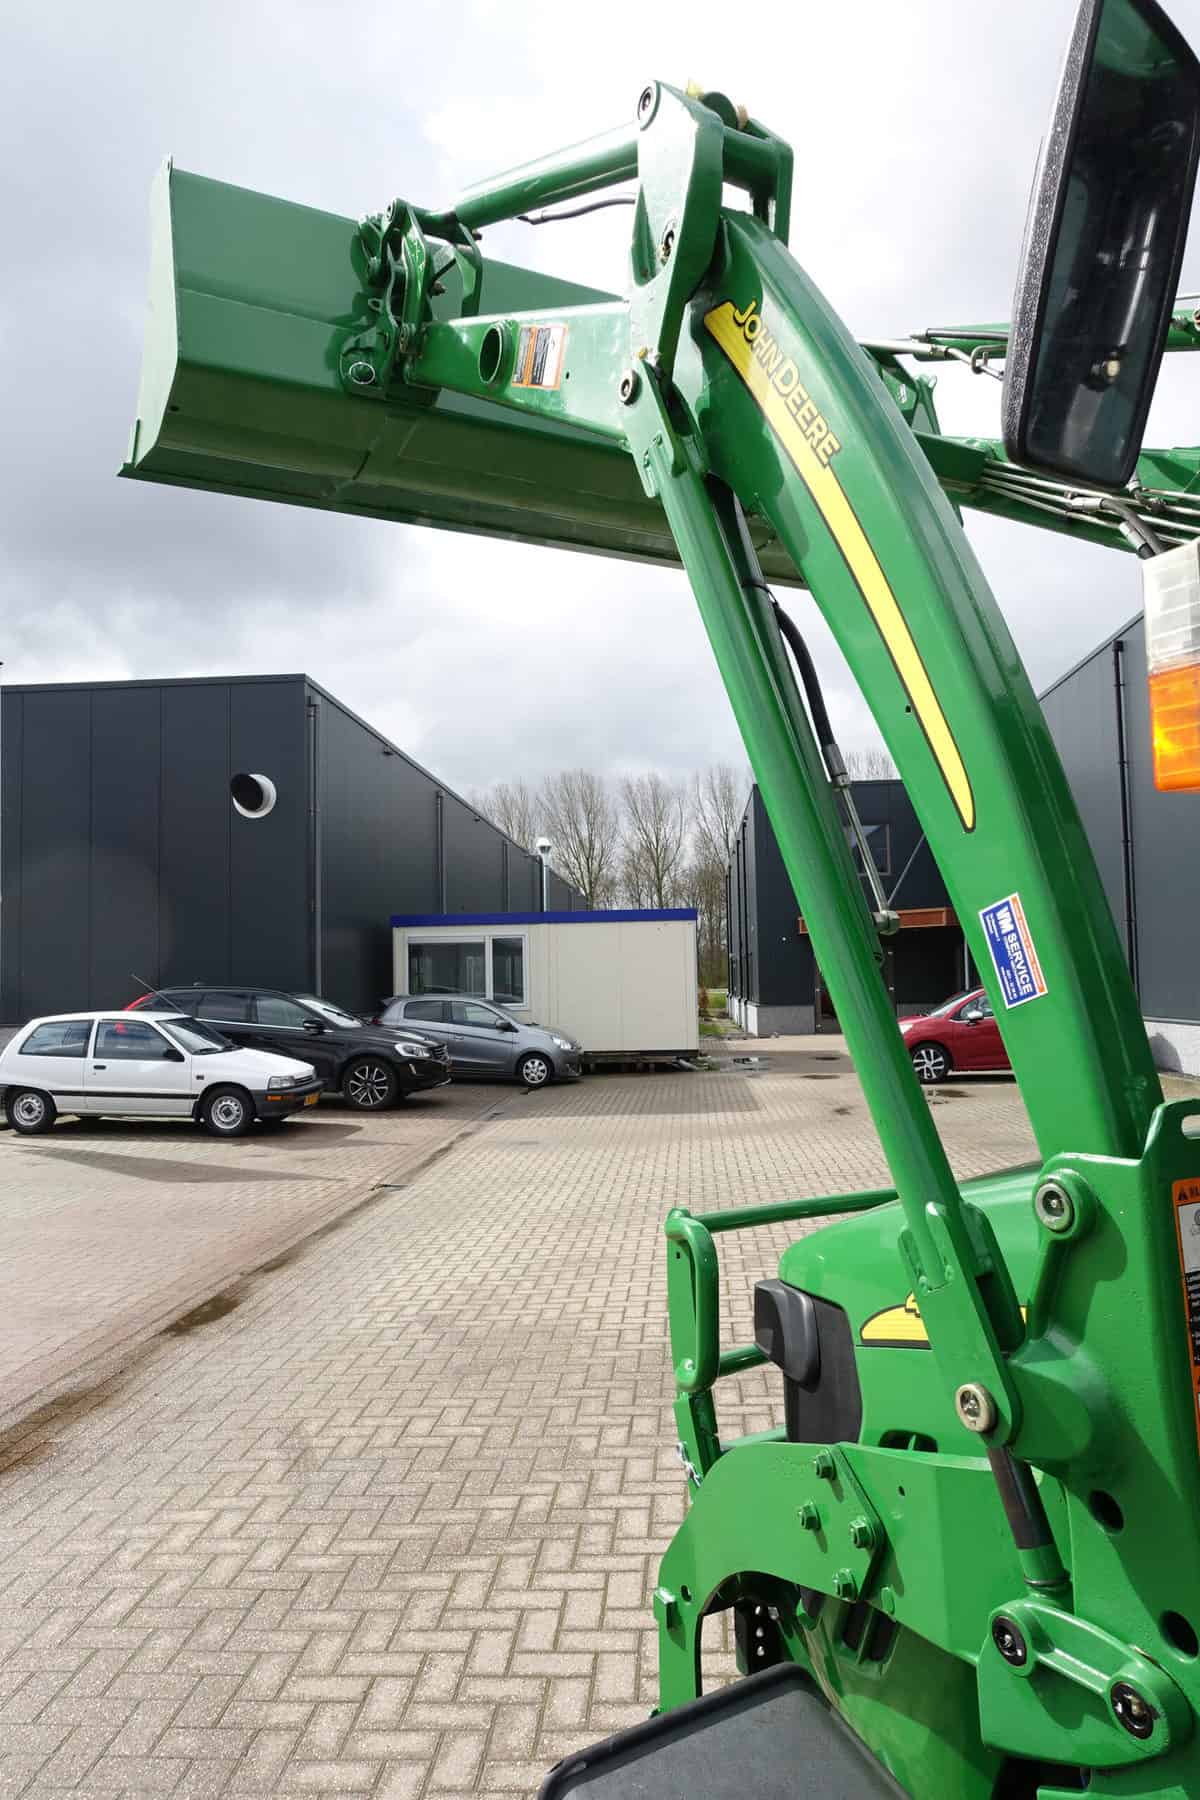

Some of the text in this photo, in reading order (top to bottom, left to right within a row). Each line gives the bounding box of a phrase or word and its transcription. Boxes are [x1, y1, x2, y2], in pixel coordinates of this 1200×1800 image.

[733, 299, 842, 468] JOHN DEERE
[1007, 933, 1033, 994] SERVICE
